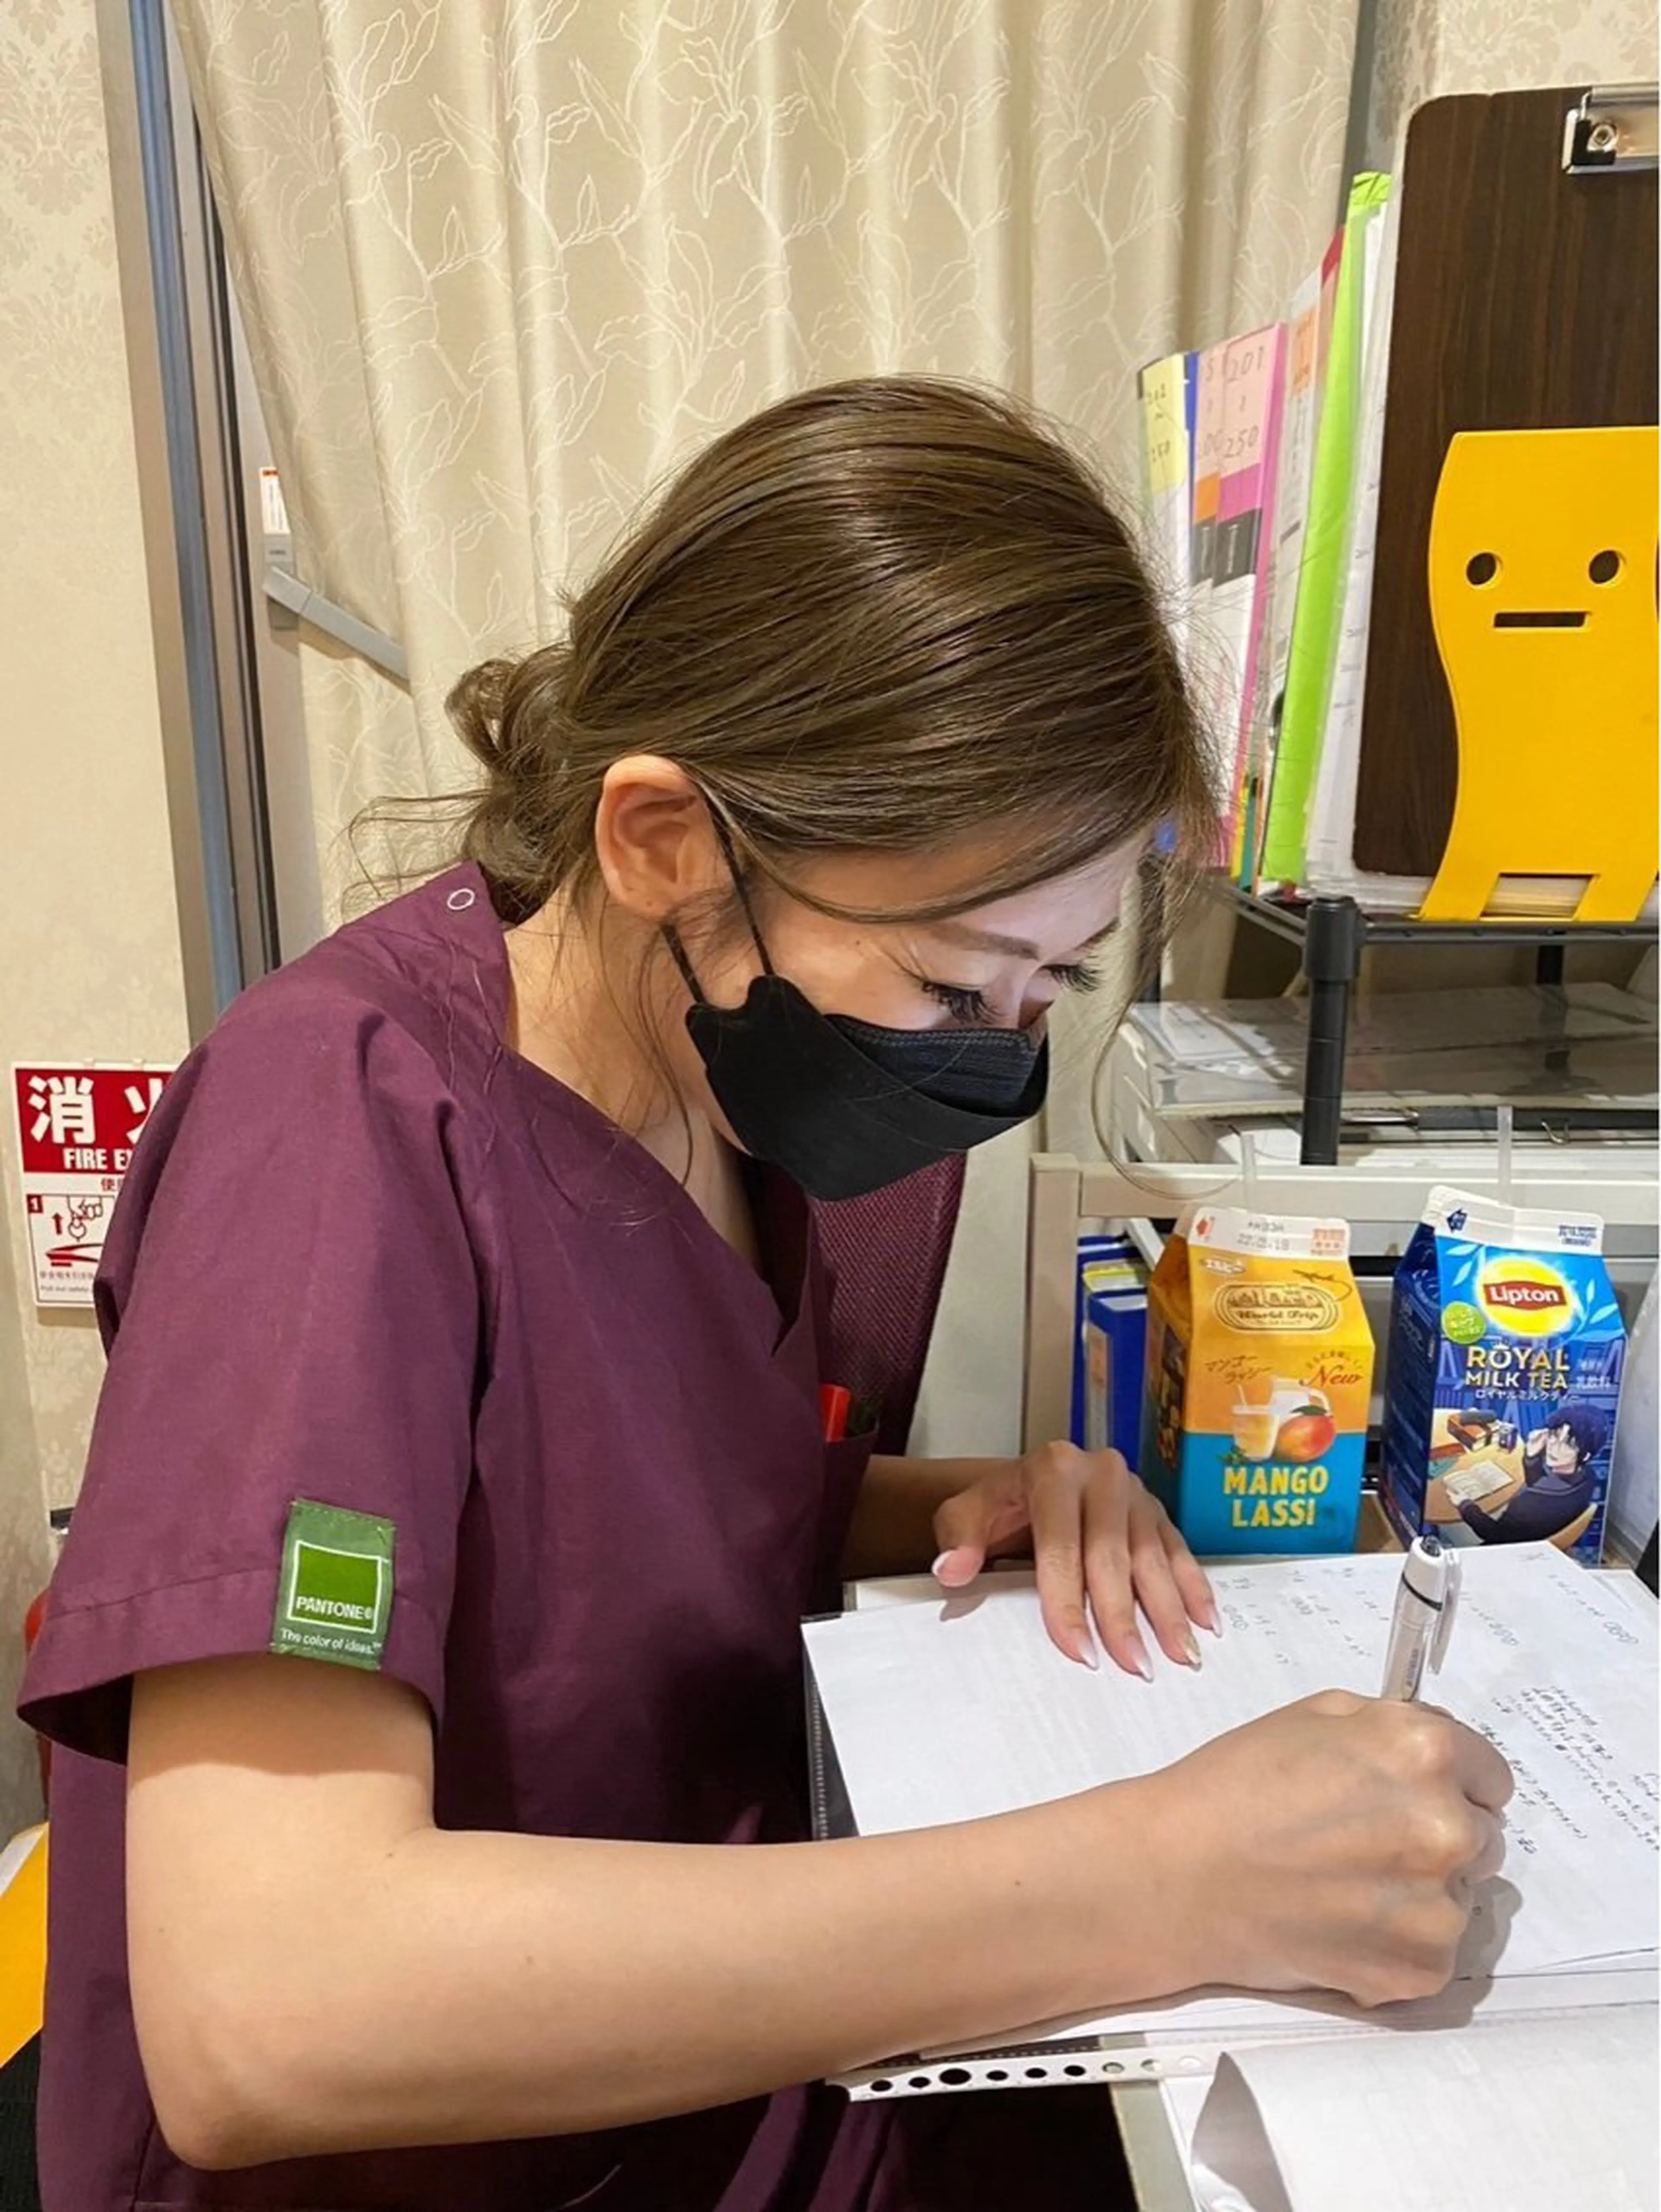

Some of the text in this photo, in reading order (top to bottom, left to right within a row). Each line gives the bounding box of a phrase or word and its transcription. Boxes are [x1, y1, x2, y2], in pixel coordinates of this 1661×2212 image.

[1223, 425, 1259, 458] 250
[64, 1148, 108, 1170] FIRE
[1490, 1286, 1559, 1305] Lipton
[1467, 1344, 1570, 1371] ROYAL
[1299, 1363, 1364, 1388] New
[1465, 1371, 1568, 1389] MILK TEA
[1223, 1465, 1329, 1496] MANGO
[1232, 1498, 1316, 1528] LASSI
[281, 1628, 300, 1642] The
[303, 1634, 331, 1648] color
[332, 1637, 343, 1649] of
